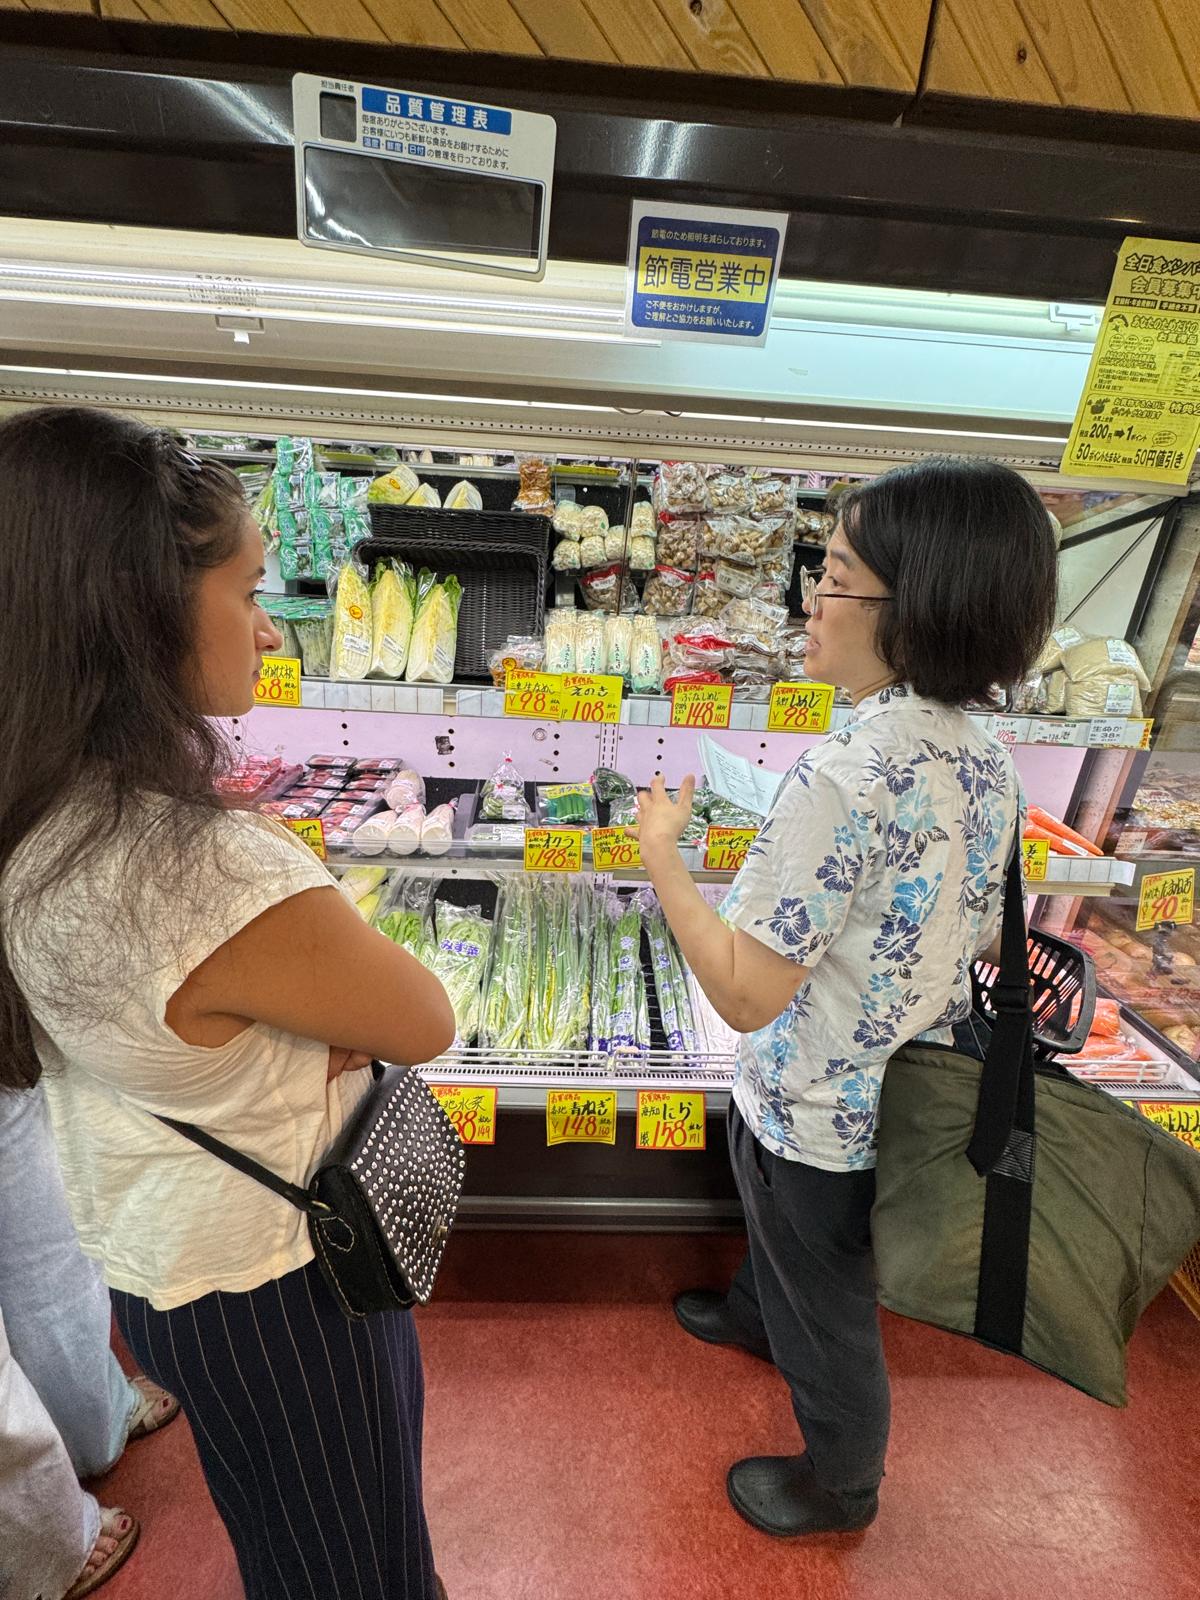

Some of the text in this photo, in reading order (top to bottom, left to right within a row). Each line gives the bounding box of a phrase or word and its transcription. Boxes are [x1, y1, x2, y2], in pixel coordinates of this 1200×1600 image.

[320, 80, 355, 93] 担当責任者
[385, 94, 488, 130] 品質管理表
[362, 126, 509, 158] お客様にいつも新鮮な食品をお届けするために
[651, 228, 767, 249] 節電のため照明を減らしております。
[643, 254, 766, 296] 節電営業中
[645, 300, 723, 315] ご不便をおかけしますが、
[644, 311, 755, 330] ご理解とご協力をお願いいたします。
[520, 690, 546, 713] 98
[571, 685, 609, 697] えのき
[790, 691, 823, 709] しめじ
[572, 700, 605, 723] 108
[685, 701, 715, 727] 148
[783, 706, 810, 728] 98
[543, 832, 575, 849] オクラ
[535, 848, 567, 868] 198
[610, 844, 634, 865] 98
[1150, 895, 1179, 921] 90
[571, 1097, 612, 1116] 青ねぎ
[662, 1102, 693, 1121] にら
[562, 1115, 597, 1137] 148
[652, 1119, 688, 1148] 158
